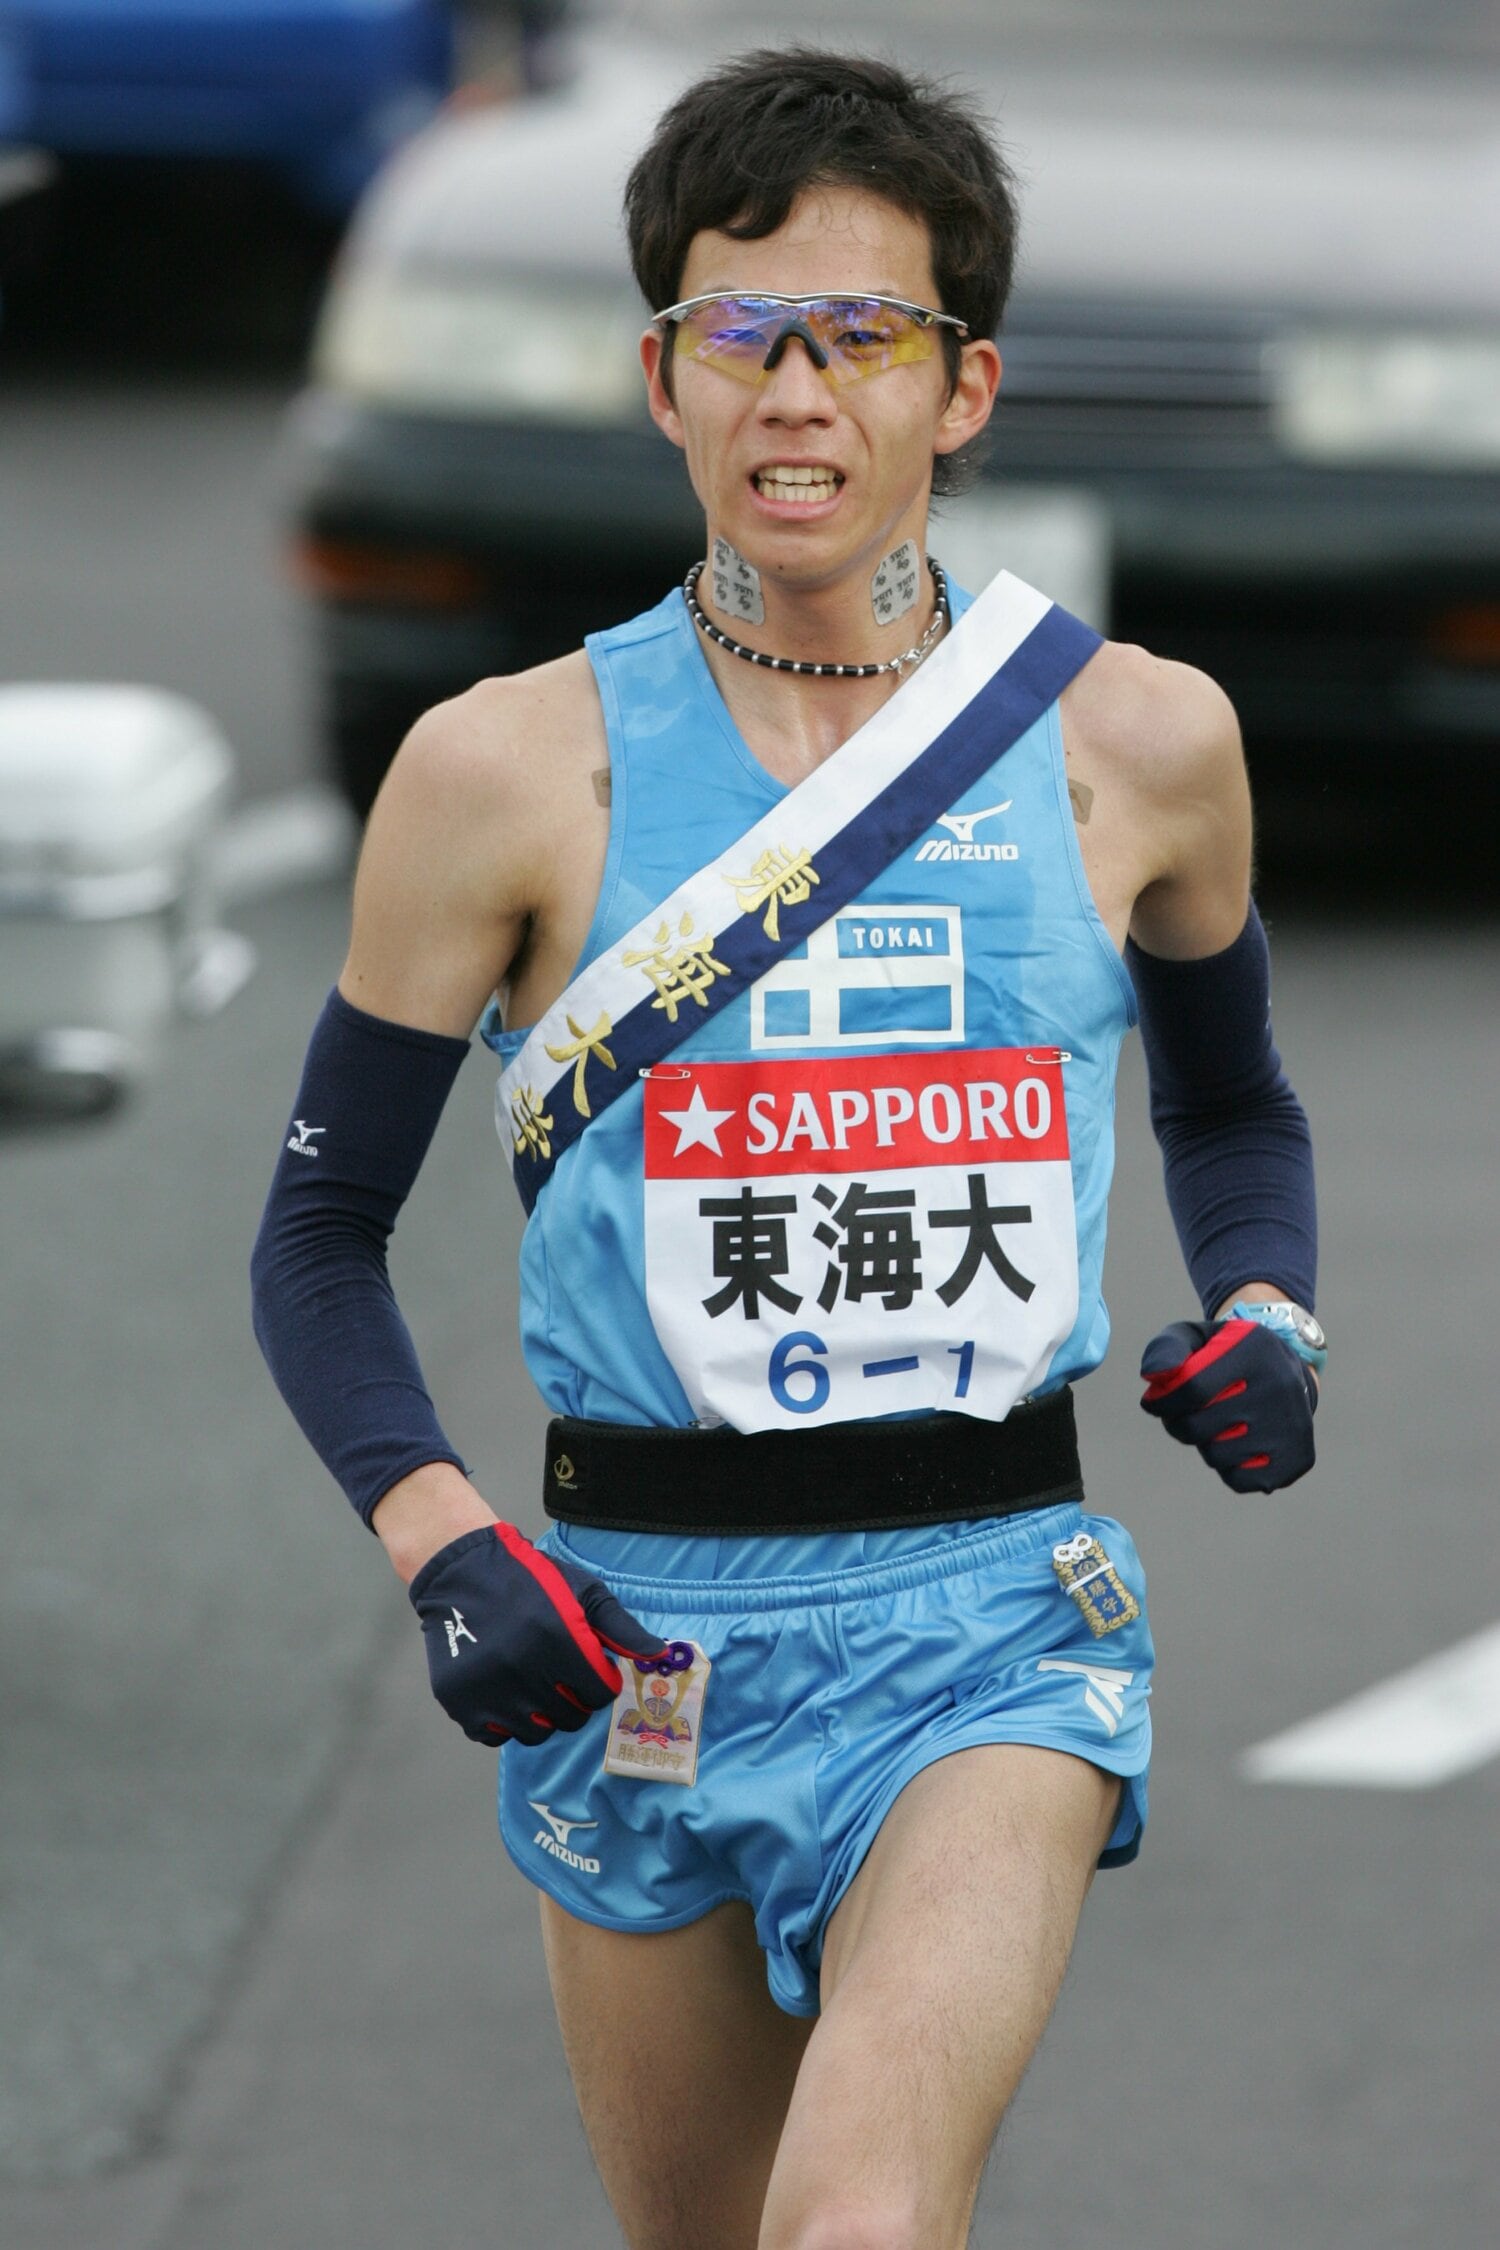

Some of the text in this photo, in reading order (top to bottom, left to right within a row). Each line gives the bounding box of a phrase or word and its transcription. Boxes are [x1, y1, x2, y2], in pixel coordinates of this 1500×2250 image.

[852, 926, 934, 949] TOKAI
[745, 1077, 1053, 1155] SAPPORO
[699, 1173, 1037, 1321] 東海大
